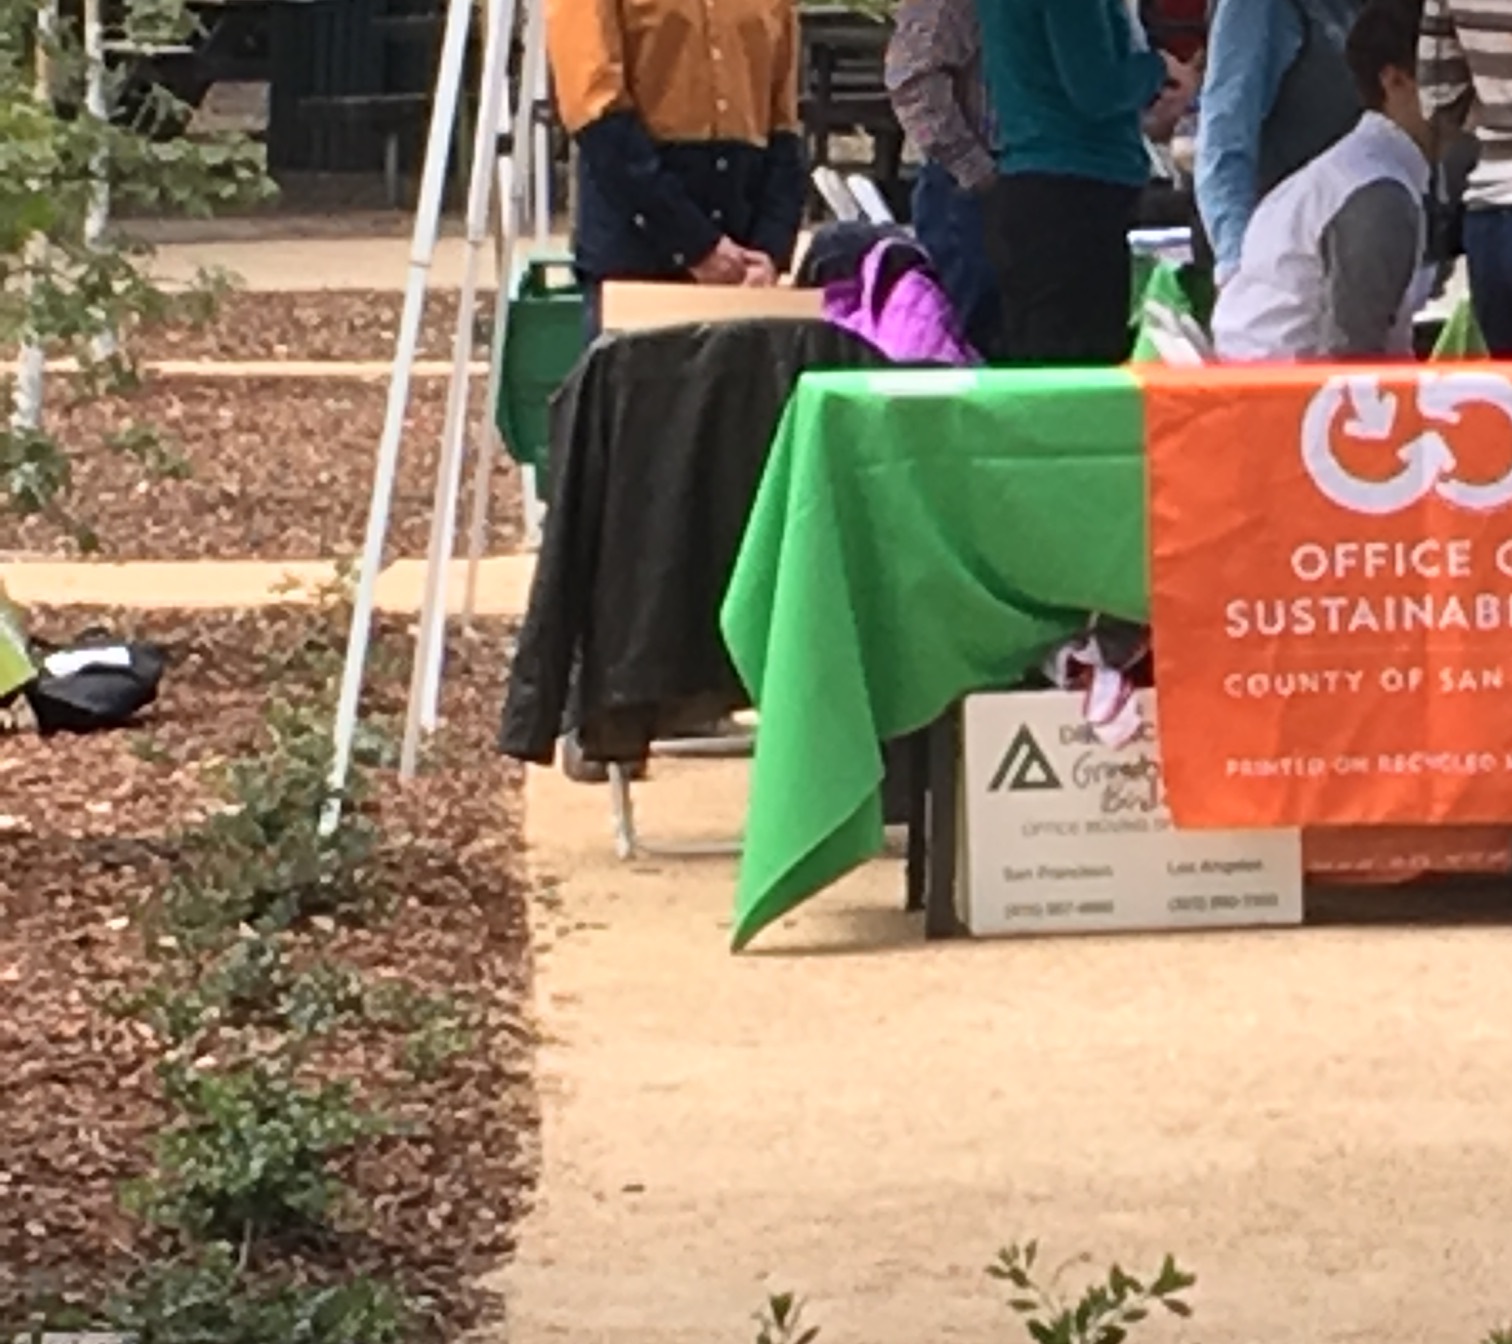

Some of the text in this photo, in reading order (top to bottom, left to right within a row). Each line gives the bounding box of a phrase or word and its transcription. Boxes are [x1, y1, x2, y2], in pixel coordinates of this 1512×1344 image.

[1291, 539, 1472, 581] OFFICE
[1224, 669, 1365, 698] COUNTY
[1380, 667, 1424, 693] OF
[1439, 666, 1504, 693] SAN
[1226, 756, 1327, 777] PRINTED
[1332, 756, 1369, 775] ON
[1378, 752, 1497, 775] RECYCLED
